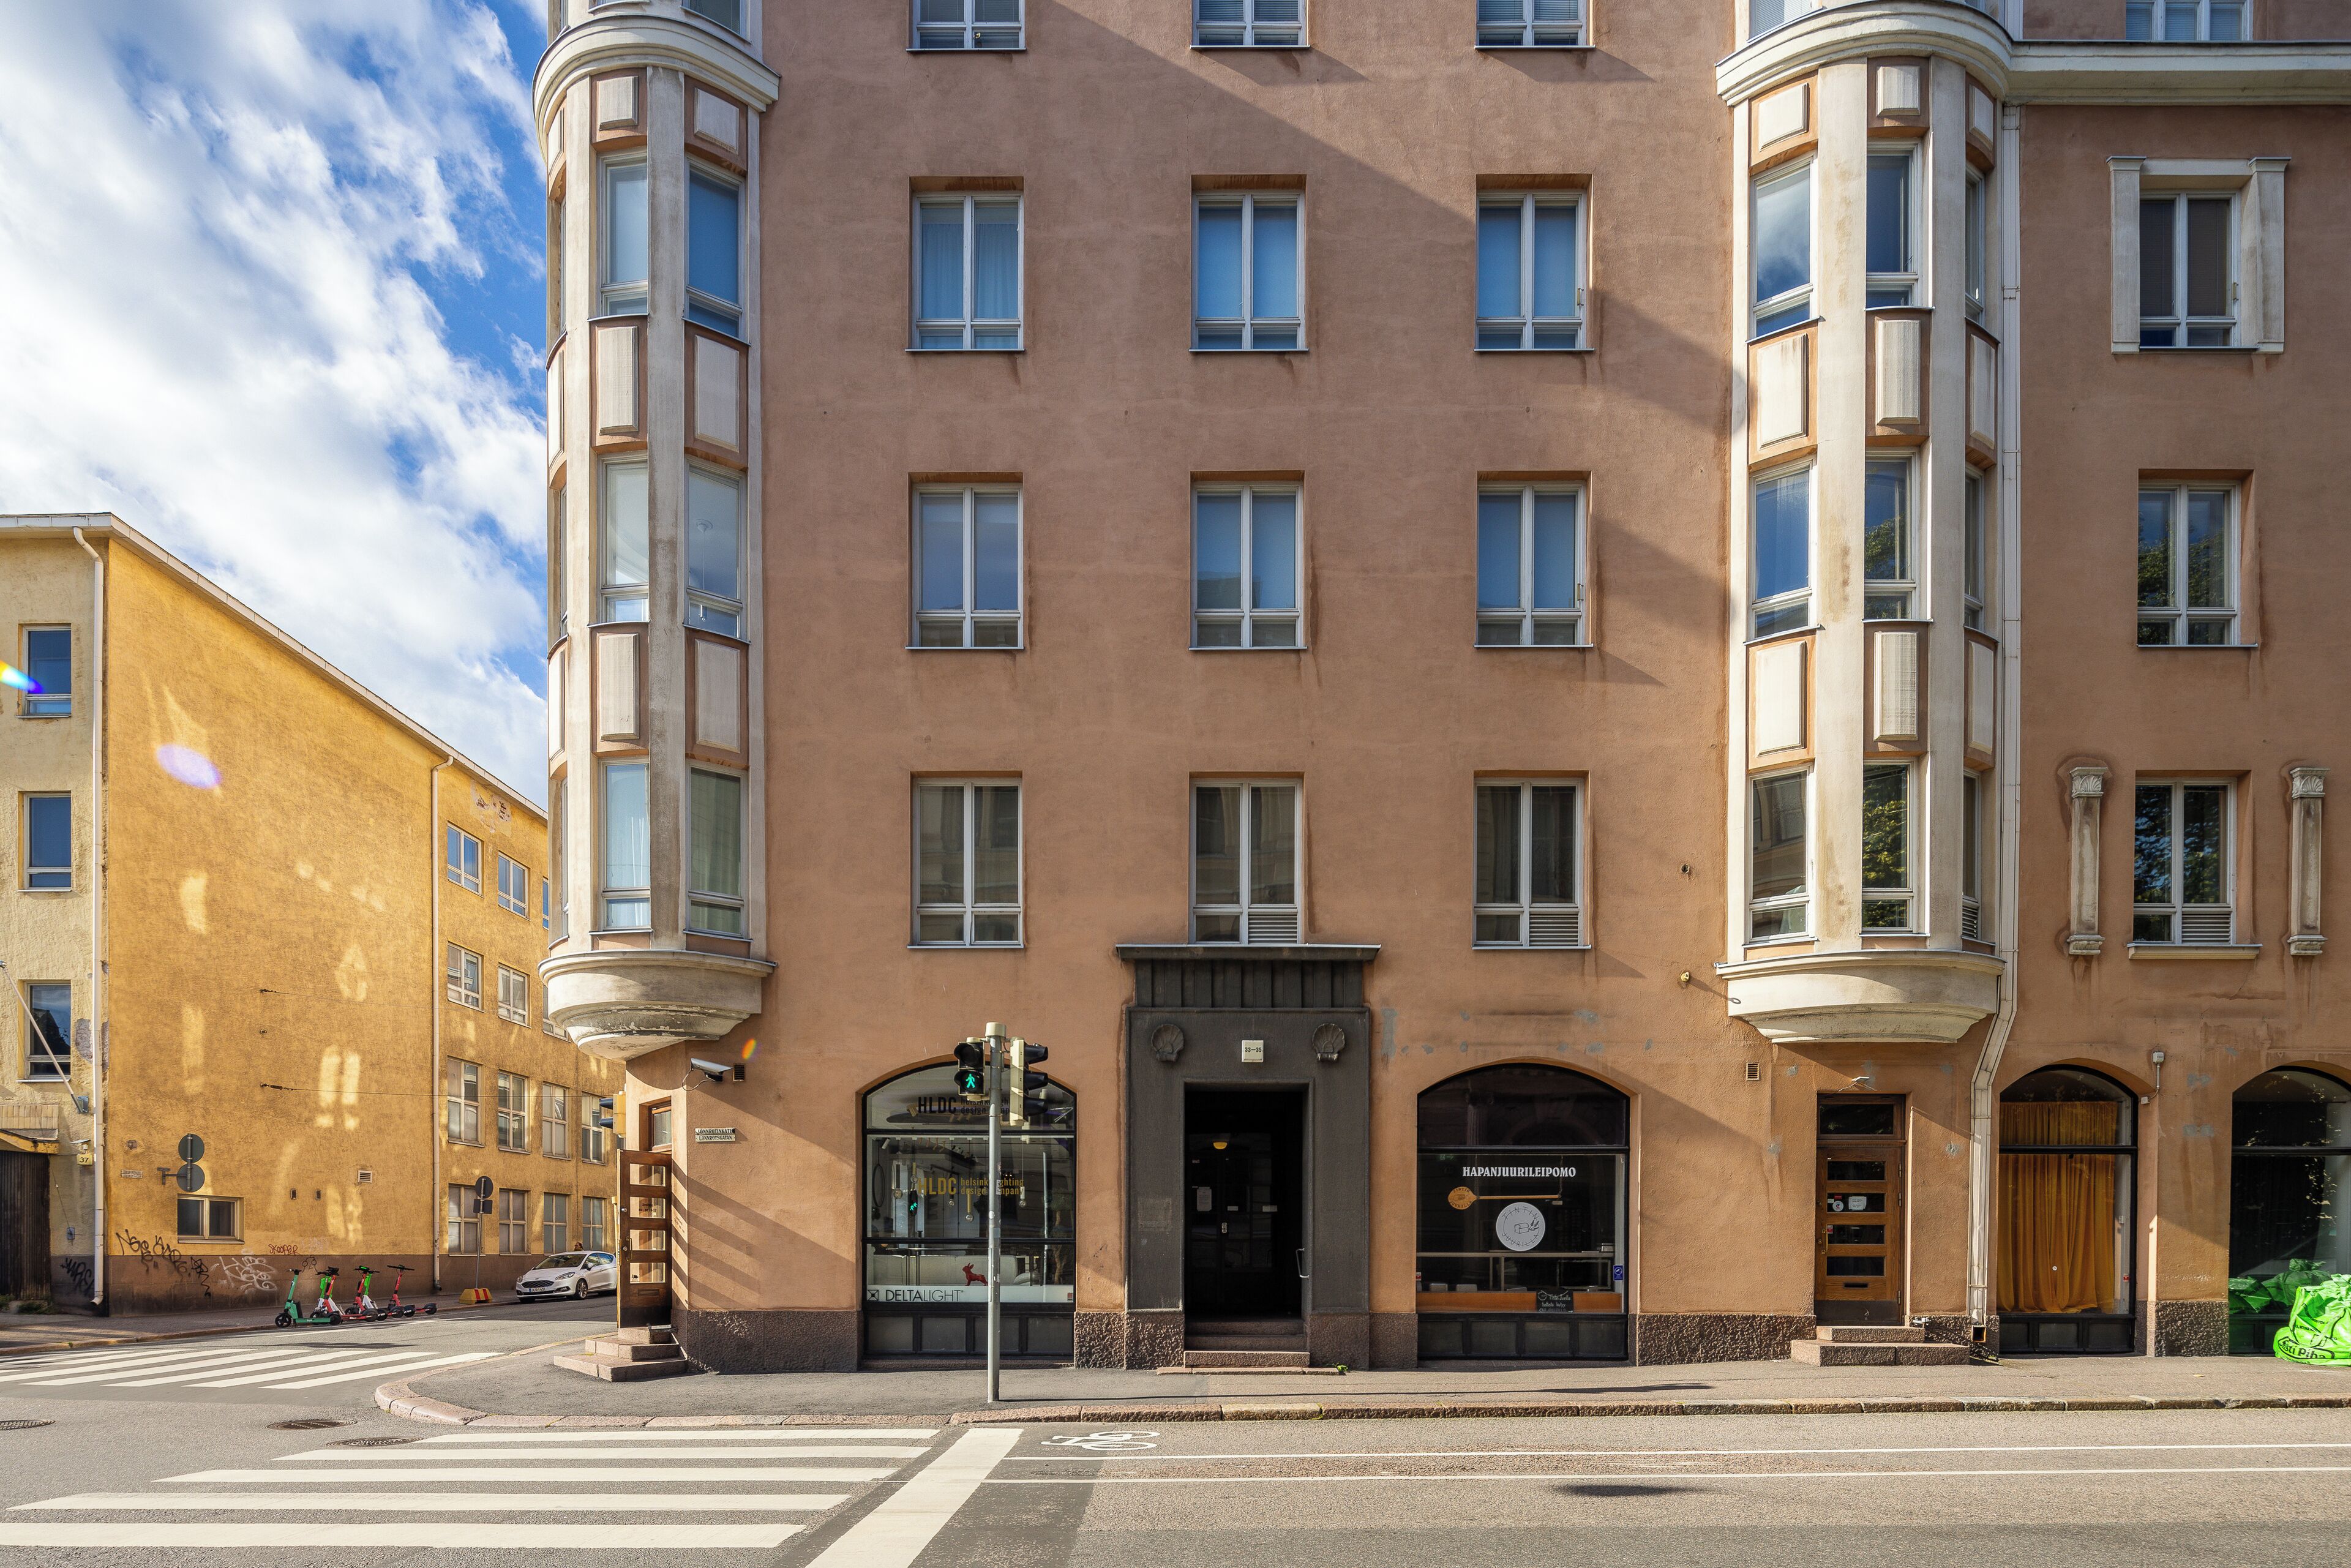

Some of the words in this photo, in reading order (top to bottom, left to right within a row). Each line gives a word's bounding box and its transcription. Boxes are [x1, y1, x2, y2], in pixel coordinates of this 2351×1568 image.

[918, 1097, 956, 1113] HLDC
[961, 1106, 986, 1115] design
[1463, 1166, 1576, 1177] HAPANJUURILEIPOMO
[918, 1177, 956, 1195] HLDC
[961, 1177, 989, 1186] helsink
[1000, 1179, 1024, 1188] ghting
[1502, 1206, 1539, 1220] TINTIN
[1502, 1233, 1539, 1247] JUURILLA
